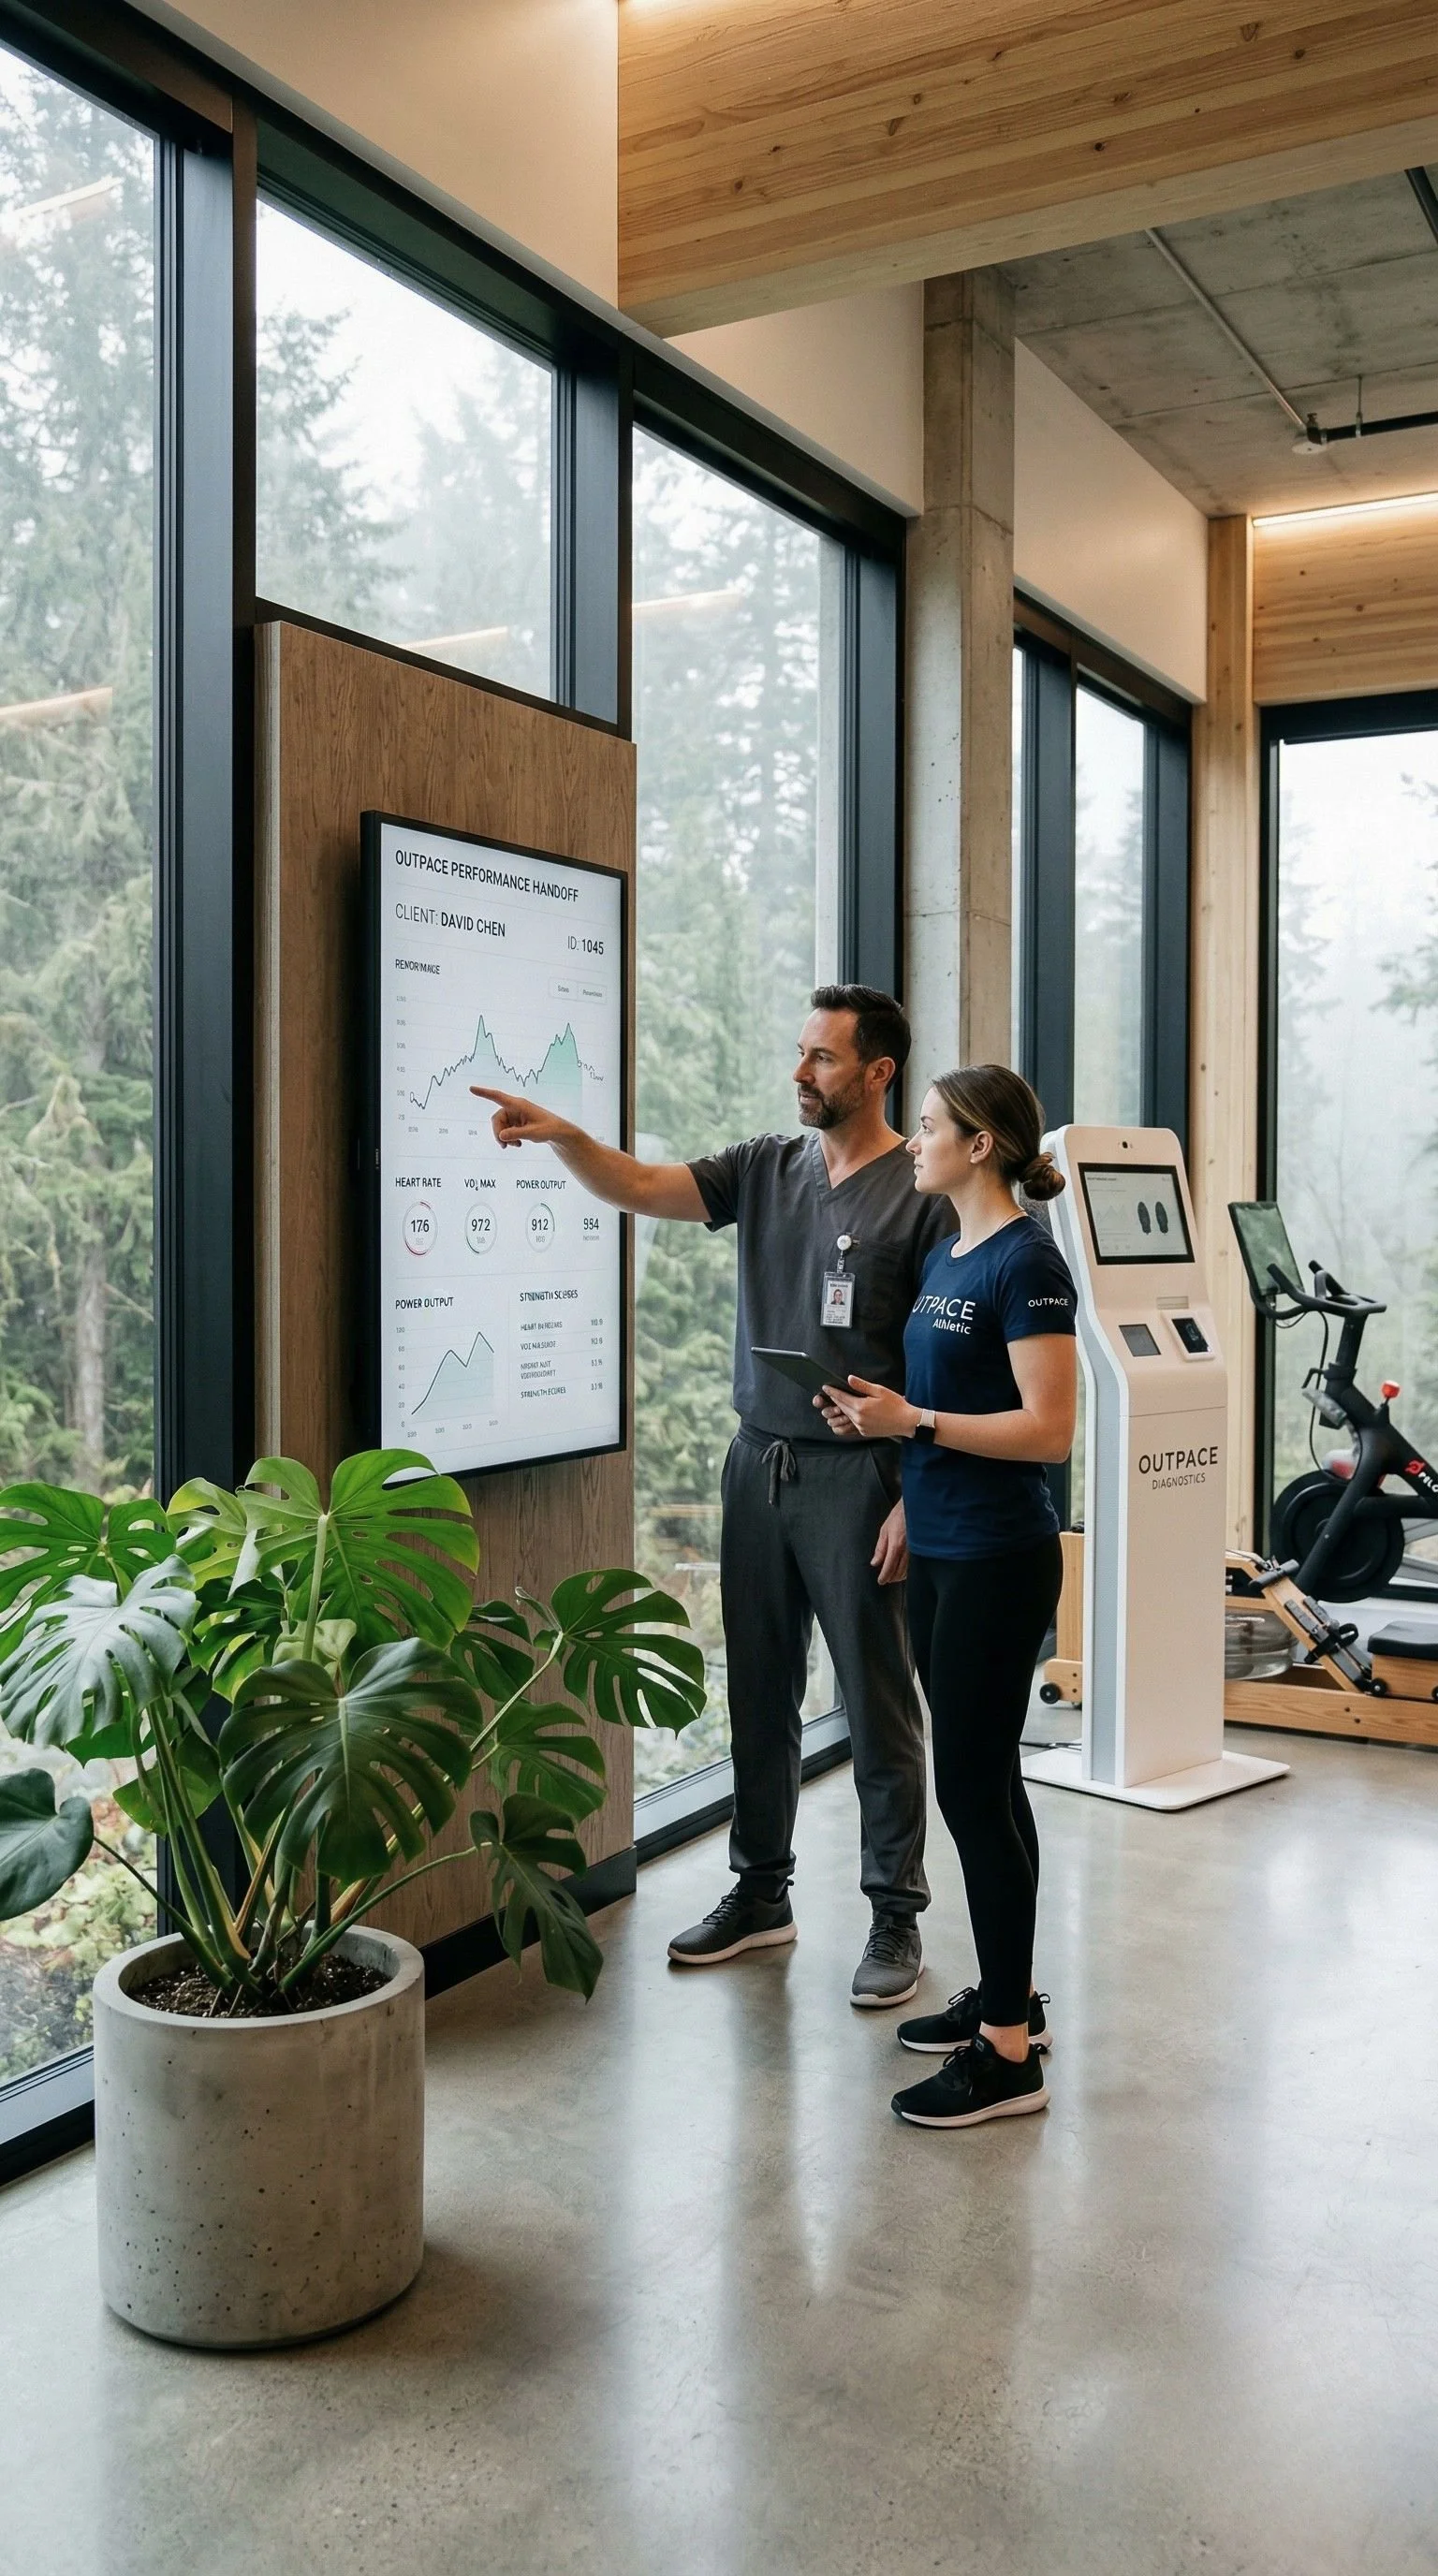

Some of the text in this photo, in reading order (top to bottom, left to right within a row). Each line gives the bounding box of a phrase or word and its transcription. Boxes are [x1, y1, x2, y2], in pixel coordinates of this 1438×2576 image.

[395, 850, 579, 902] OUTPACE PERFORMANCE HANDOFF
[395, 903, 506, 937] CLIENT: DAVID CHEN
[581, 938, 605, 956] 1045
[395, 1177, 442, 1188] HEART RATE
[479, 1179, 496, 1189] MAX
[516, 1179, 566, 1190] POWER OUTPUT
[410, 1219, 430, 1233] 176
[471, 1218, 491, 1232] 972
[531, 1218, 549, 1231] 912
[395, 1296, 454, 1310] POWER OUTPUT
[912, 1295, 976, 1321] UTPACE
[1028, 1297, 1069, 1308] OUTPACE
[1138, 1446, 1219, 1474] OUTPACE
[1152, 1472, 1207, 1490] DIAGNOSTICS
